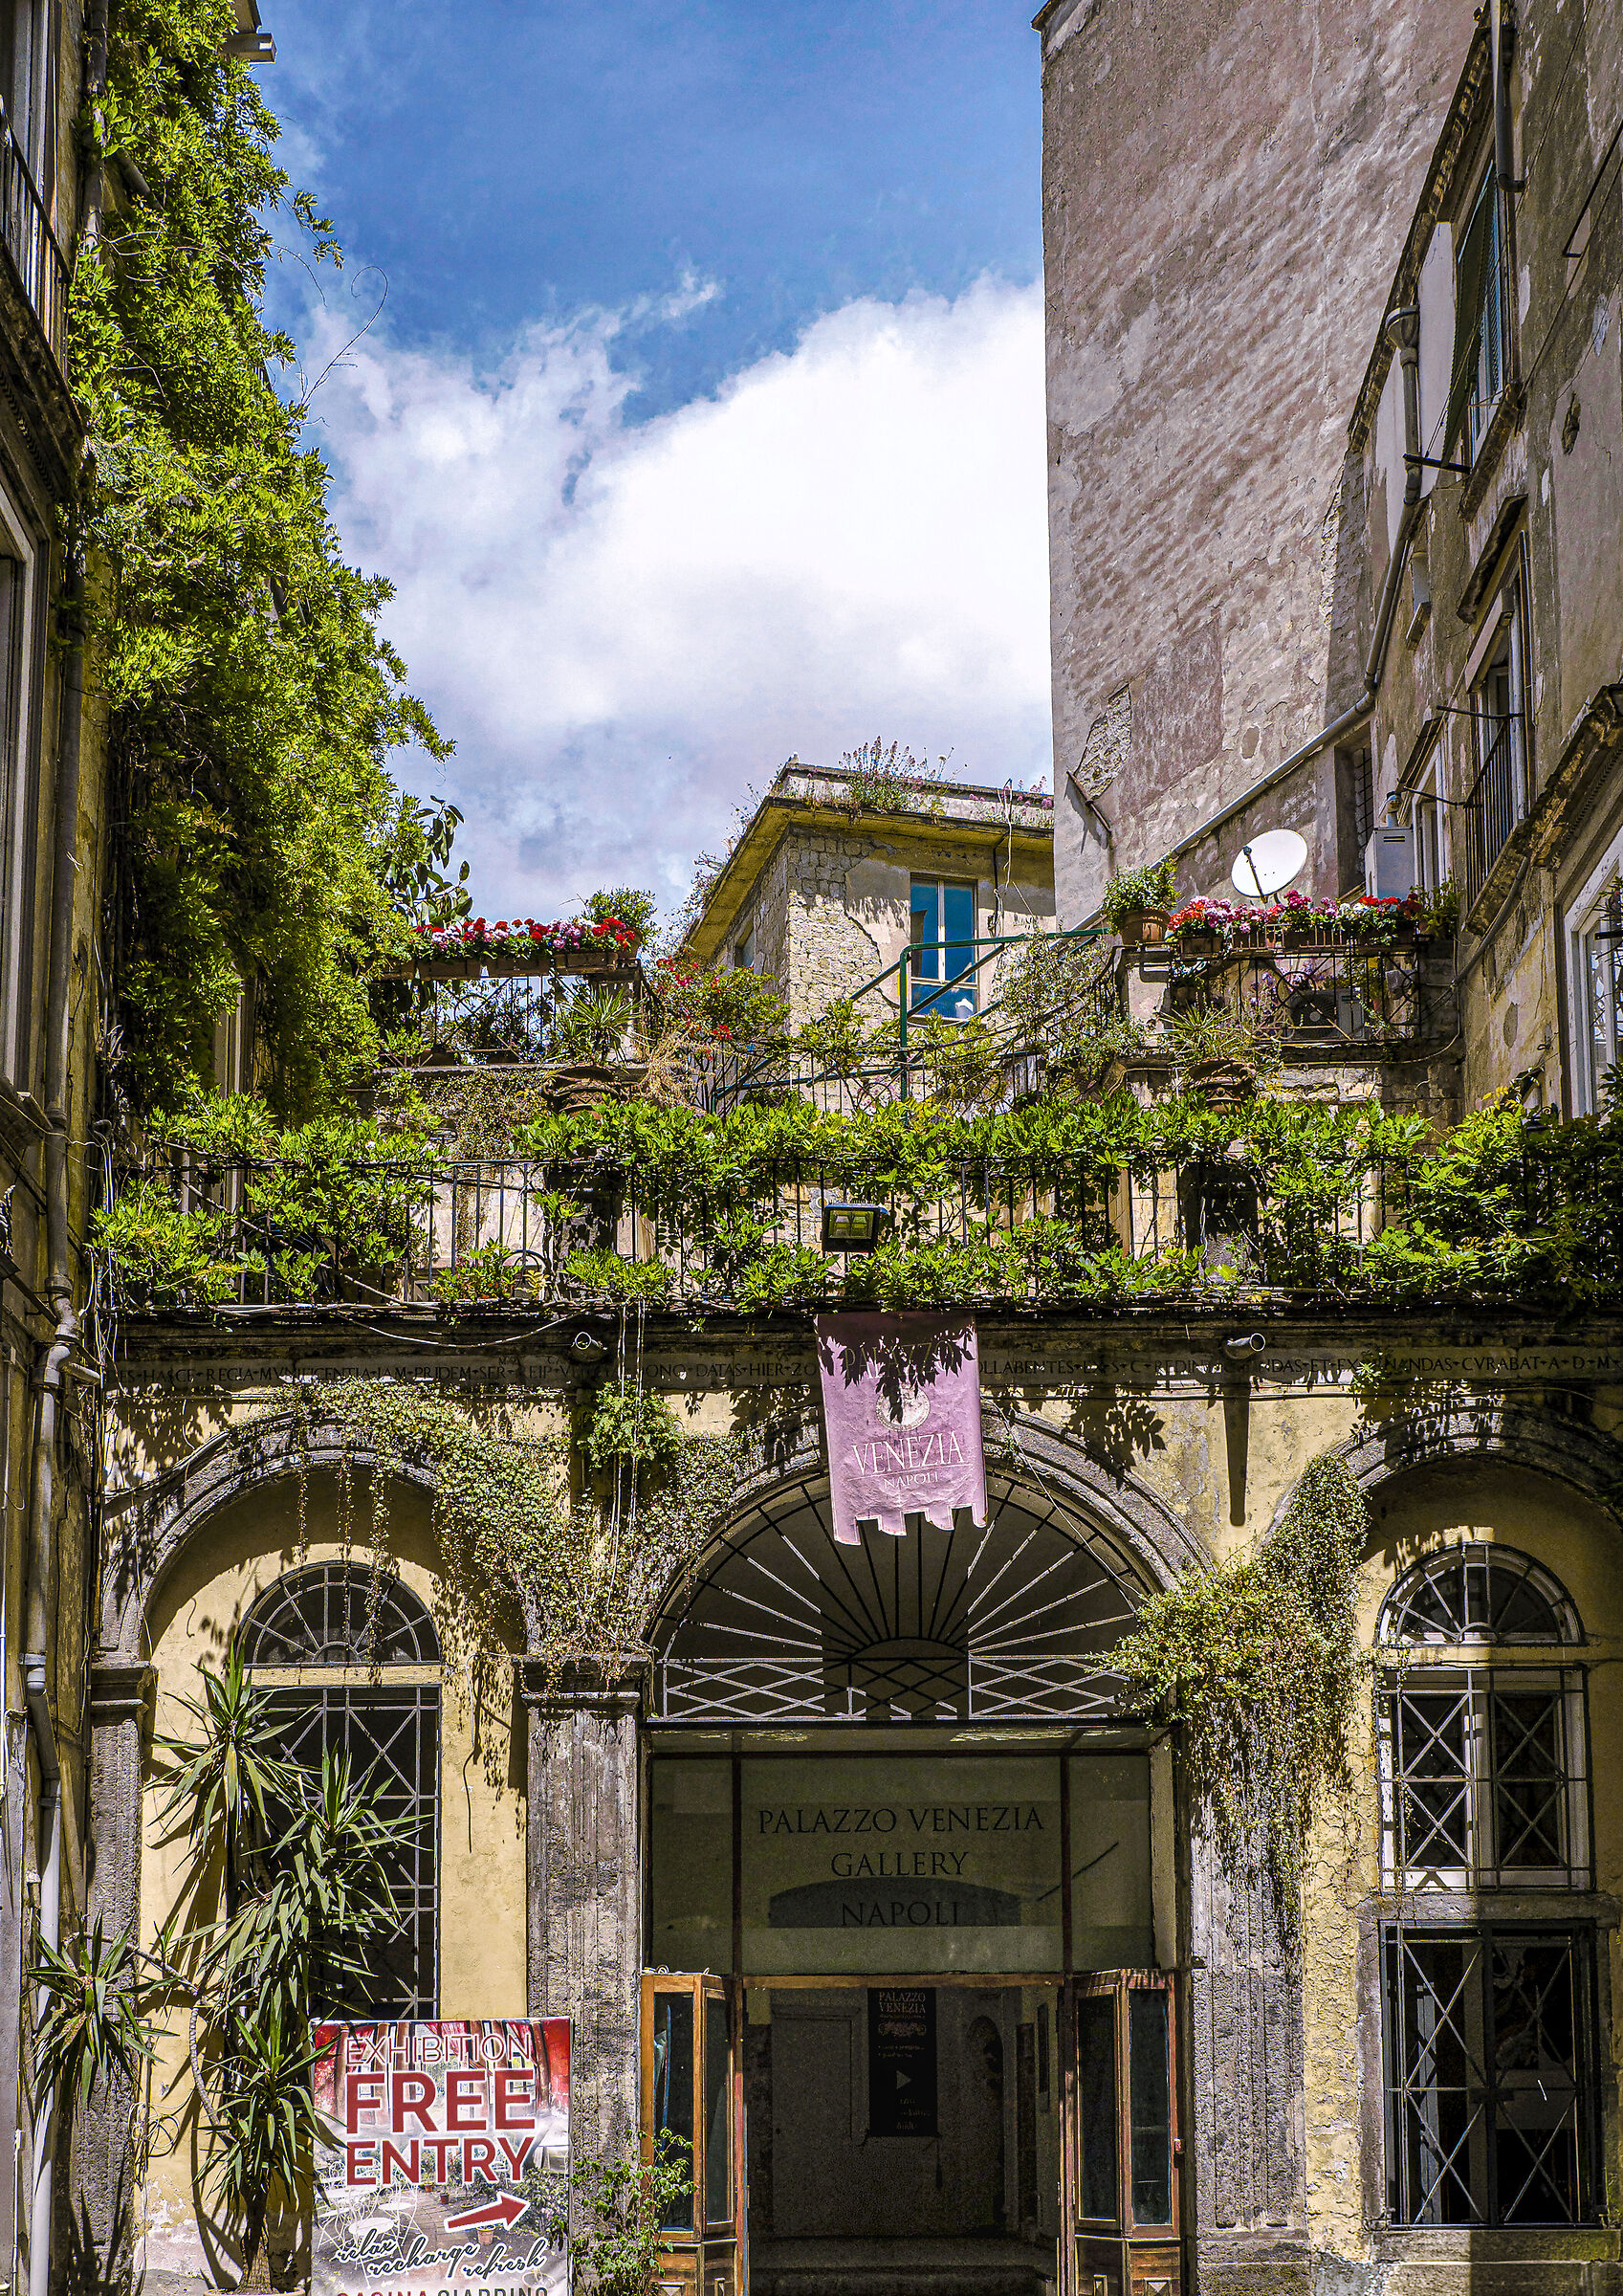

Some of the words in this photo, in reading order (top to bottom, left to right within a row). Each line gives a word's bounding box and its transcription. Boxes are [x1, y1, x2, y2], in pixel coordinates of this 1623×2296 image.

[207, 1367, 253, 1381] REGIA
[414, 1367, 472, 1380] PRIDEM
[639, 1364, 686, 1378] ONO
[696, 1364, 741, 1378] DATAS
[1310, 1359, 1329, 1374] ET
[1462, 1357, 1541, 1371] CVRABAT
[1548, 1357, 1560, 1370] A
[1573, 1357, 1586, 1370] D
[844, 1341, 954, 1379] PALAZZO
[851, 1431, 965, 1476] VENEZIA
[883, 1471, 938, 1490] NAPOLI
[758, 1808, 897, 1834] PALAZZO
[908, 1806, 1044, 1832] VENEZIA
[831, 1851, 969, 1877] GALLERY
[842, 1901, 958, 1927] NAPOLI
[879, 1992, 926, 2002] PALAZZO
[879, 2002, 926, 2014] VENEZIA
[346, 2034, 532, 2064] EXHIBITION
[346, 2070, 536, 2134] FREE
[346, 2136, 535, 2185] ENTRY
[338, 2229, 396, 2262] relax
[369, 2237, 478, 2277] recharge
[463, 2240, 546, 2278] refresh
